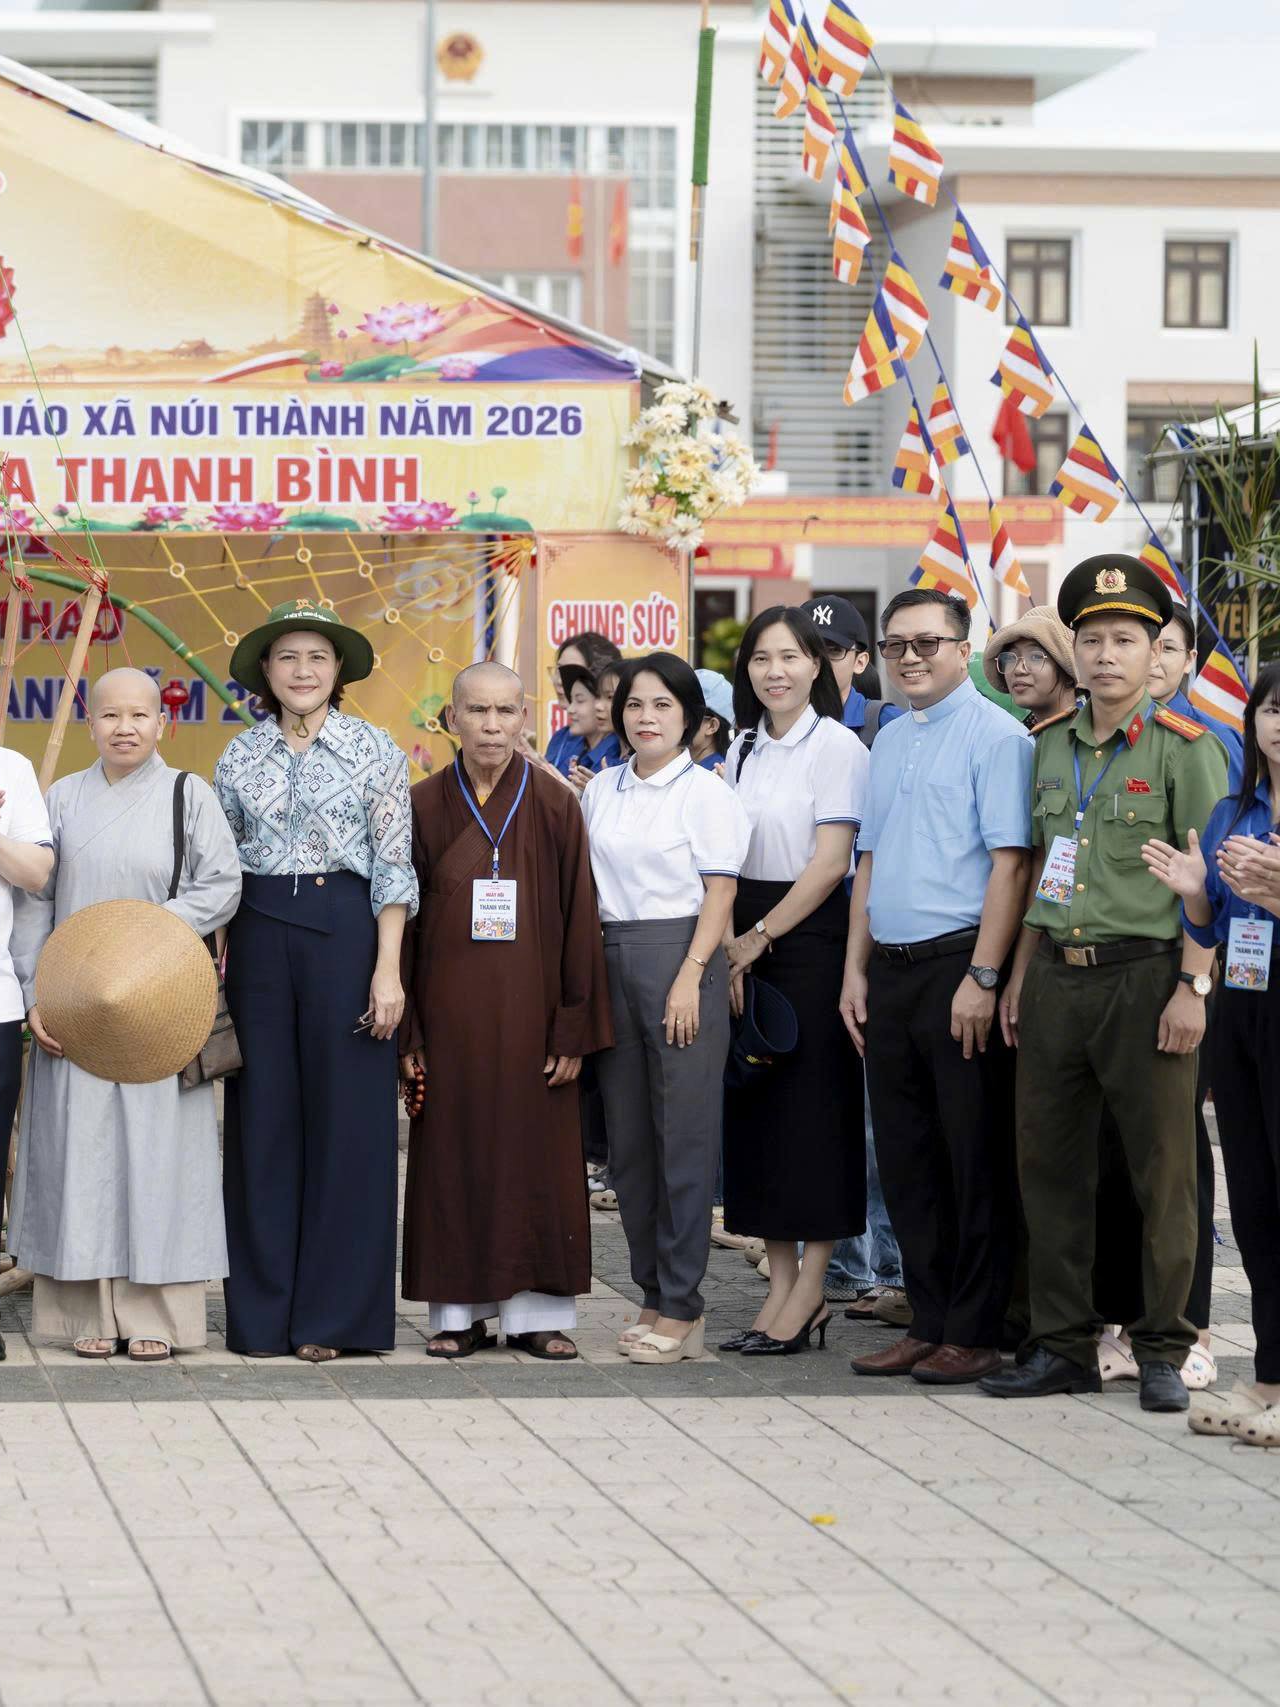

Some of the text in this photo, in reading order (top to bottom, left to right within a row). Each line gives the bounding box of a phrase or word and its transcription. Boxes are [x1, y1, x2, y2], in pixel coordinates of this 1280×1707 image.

[83, 398, 136, 436] XÃ
[150, 398, 218, 436] NÚI
[233, 398, 364, 436] THÀNH
[380, 398, 472, 436] NĂM
[487, 405, 582, 437] 2026
[57, 457, 253, 503] THANH
[277, 447, 418, 503] BÌNH
[551, 595, 676, 646] CHUNG SỨC
